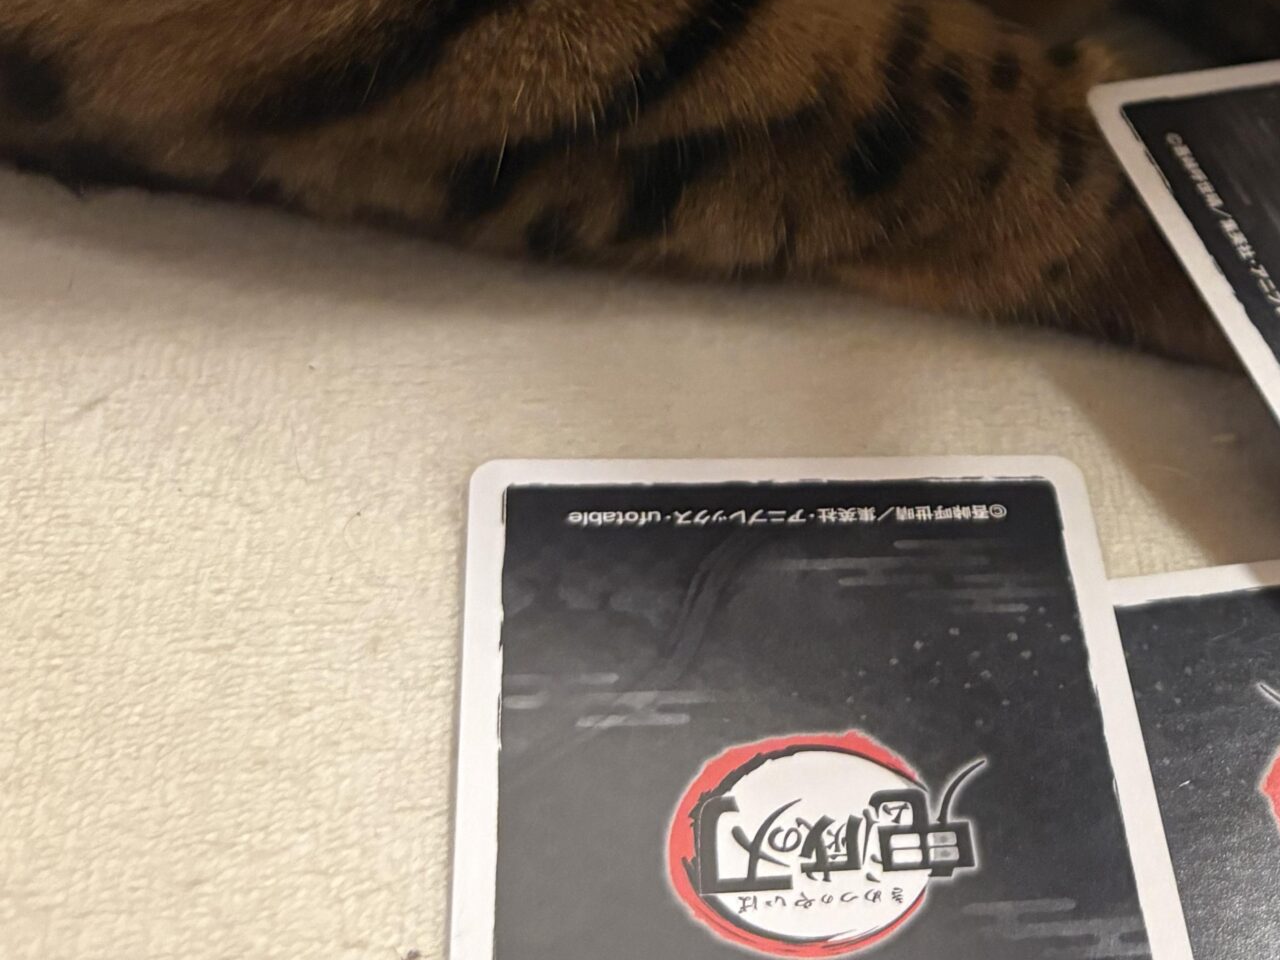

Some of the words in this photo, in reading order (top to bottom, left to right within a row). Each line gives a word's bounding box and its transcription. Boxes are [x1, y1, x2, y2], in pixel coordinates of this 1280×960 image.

[696, 758, 986, 895] 鬼滅の刃
[736, 887, 904, 913] きめつのやいば
